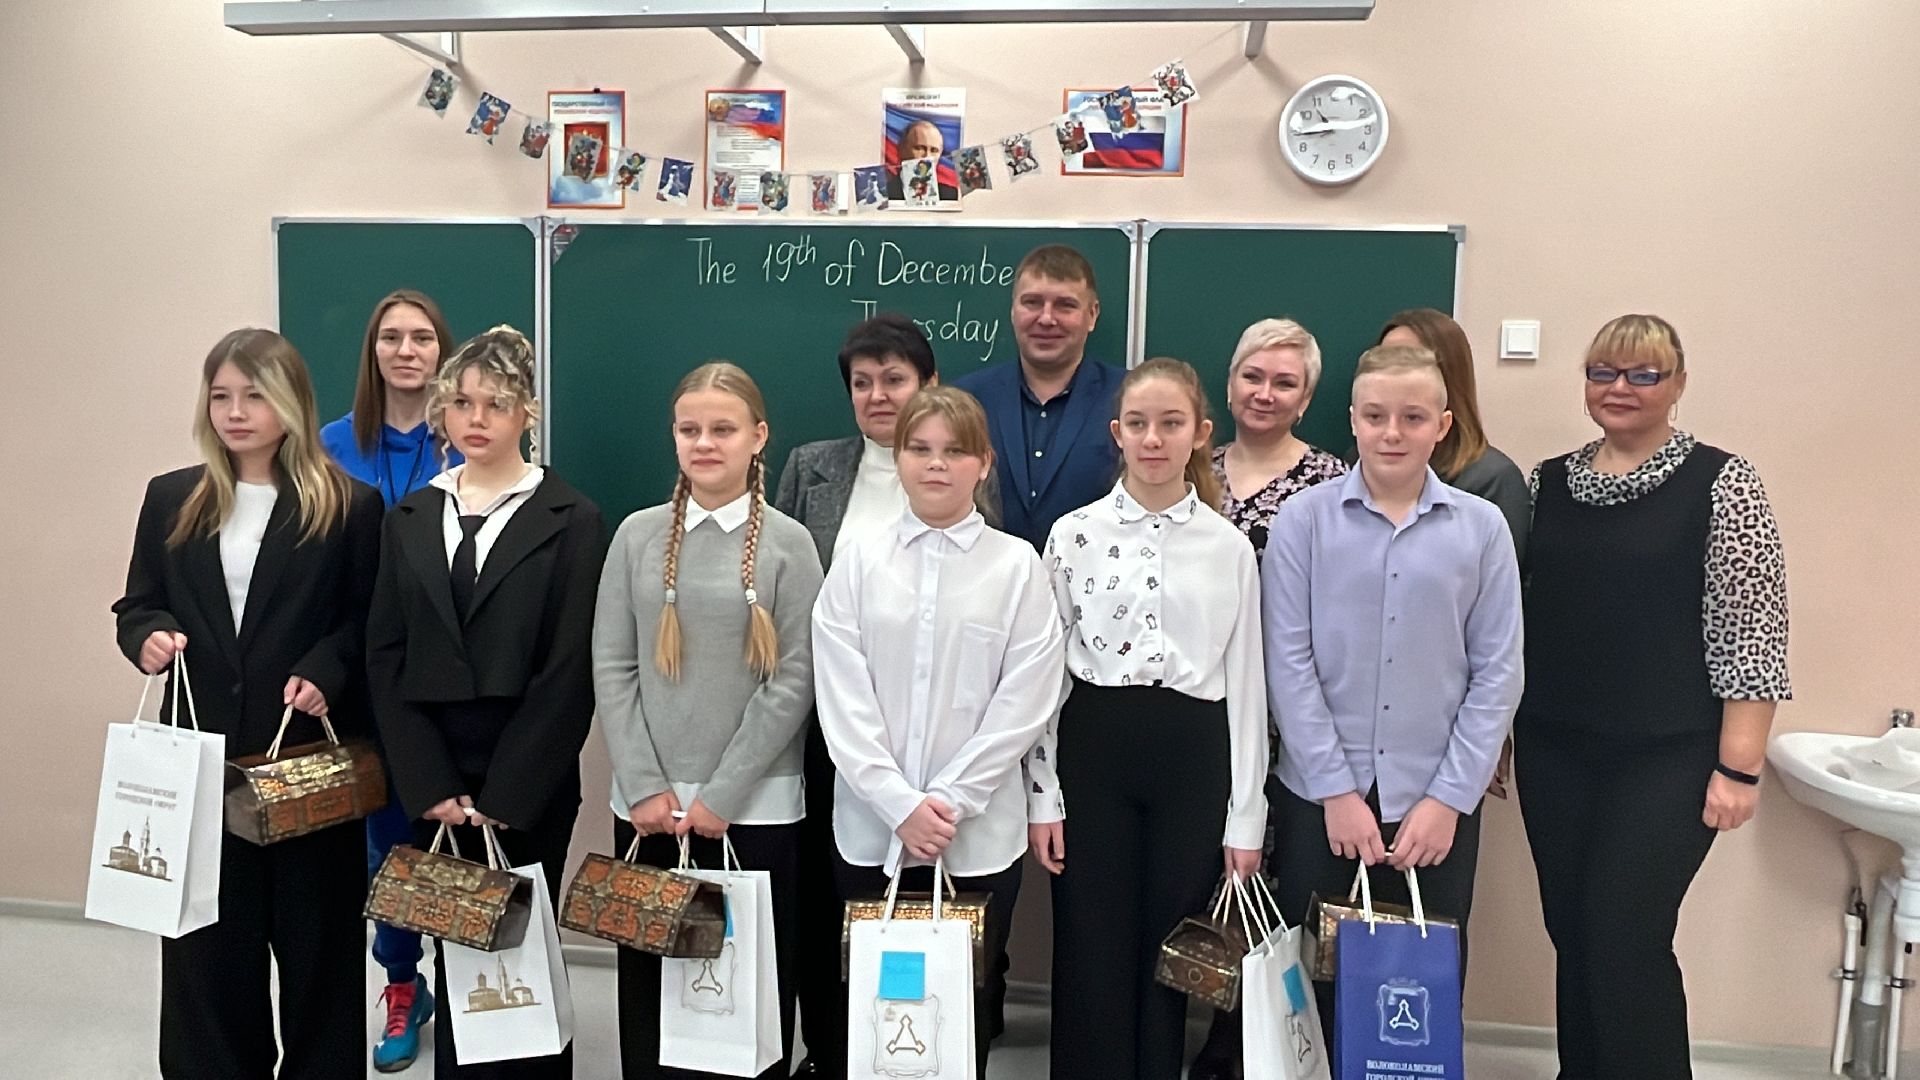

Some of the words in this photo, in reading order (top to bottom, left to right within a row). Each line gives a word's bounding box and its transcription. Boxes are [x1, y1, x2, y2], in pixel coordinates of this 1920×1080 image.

[1364, 125, 1372, 136] 3
[1299, 142, 1307, 153] 8
[1358, 141, 1366, 151] 4
[1312, 154, 1319, 165] 7
[1345, 154, 1353, 165] 5
[1327, 160, 1336, 171] 6
[686, 237, 737, 286] The
[762, 234, 817, 283] 19th
[824, 238, 866, 287] of
[877, 240, 1015, 287] Decembe
